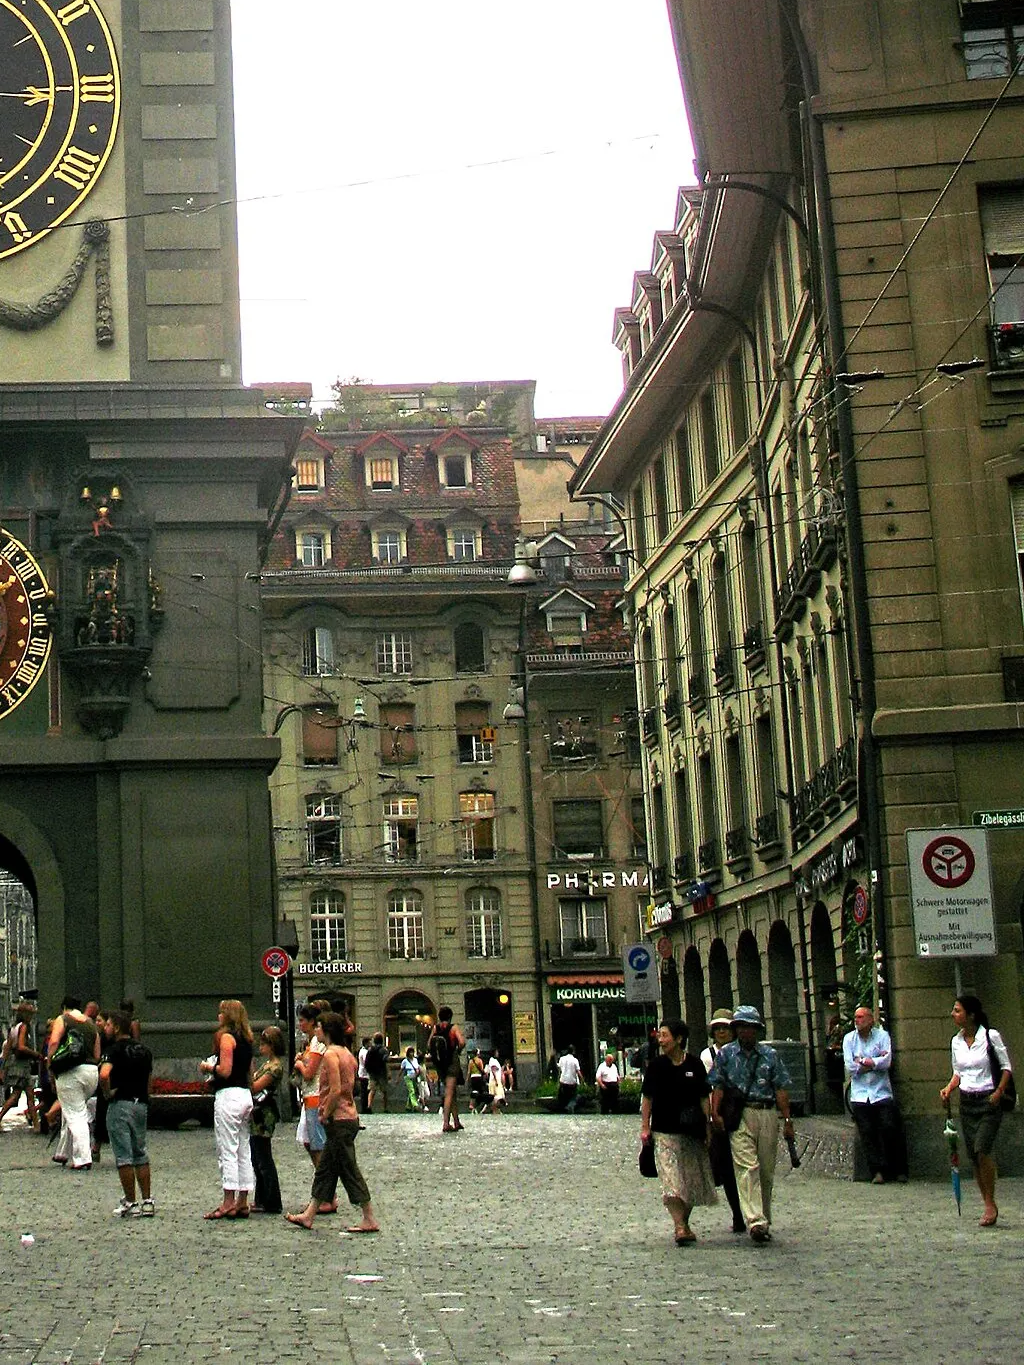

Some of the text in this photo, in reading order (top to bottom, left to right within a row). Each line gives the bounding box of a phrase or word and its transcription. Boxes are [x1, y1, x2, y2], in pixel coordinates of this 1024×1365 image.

[916, 897, 989, 907] Schwere Motorwagen
[937, 907, 969, 917] gestattet
[948, 923, 961, 931] Mit
[918, 932, 993, 943] Ausnahmebewilligung
[941, 941, 973, 951] gestattet
[299, 962, 363, 974] BUCHERER
[556, 988, 626, 1000] KORNHAUS
